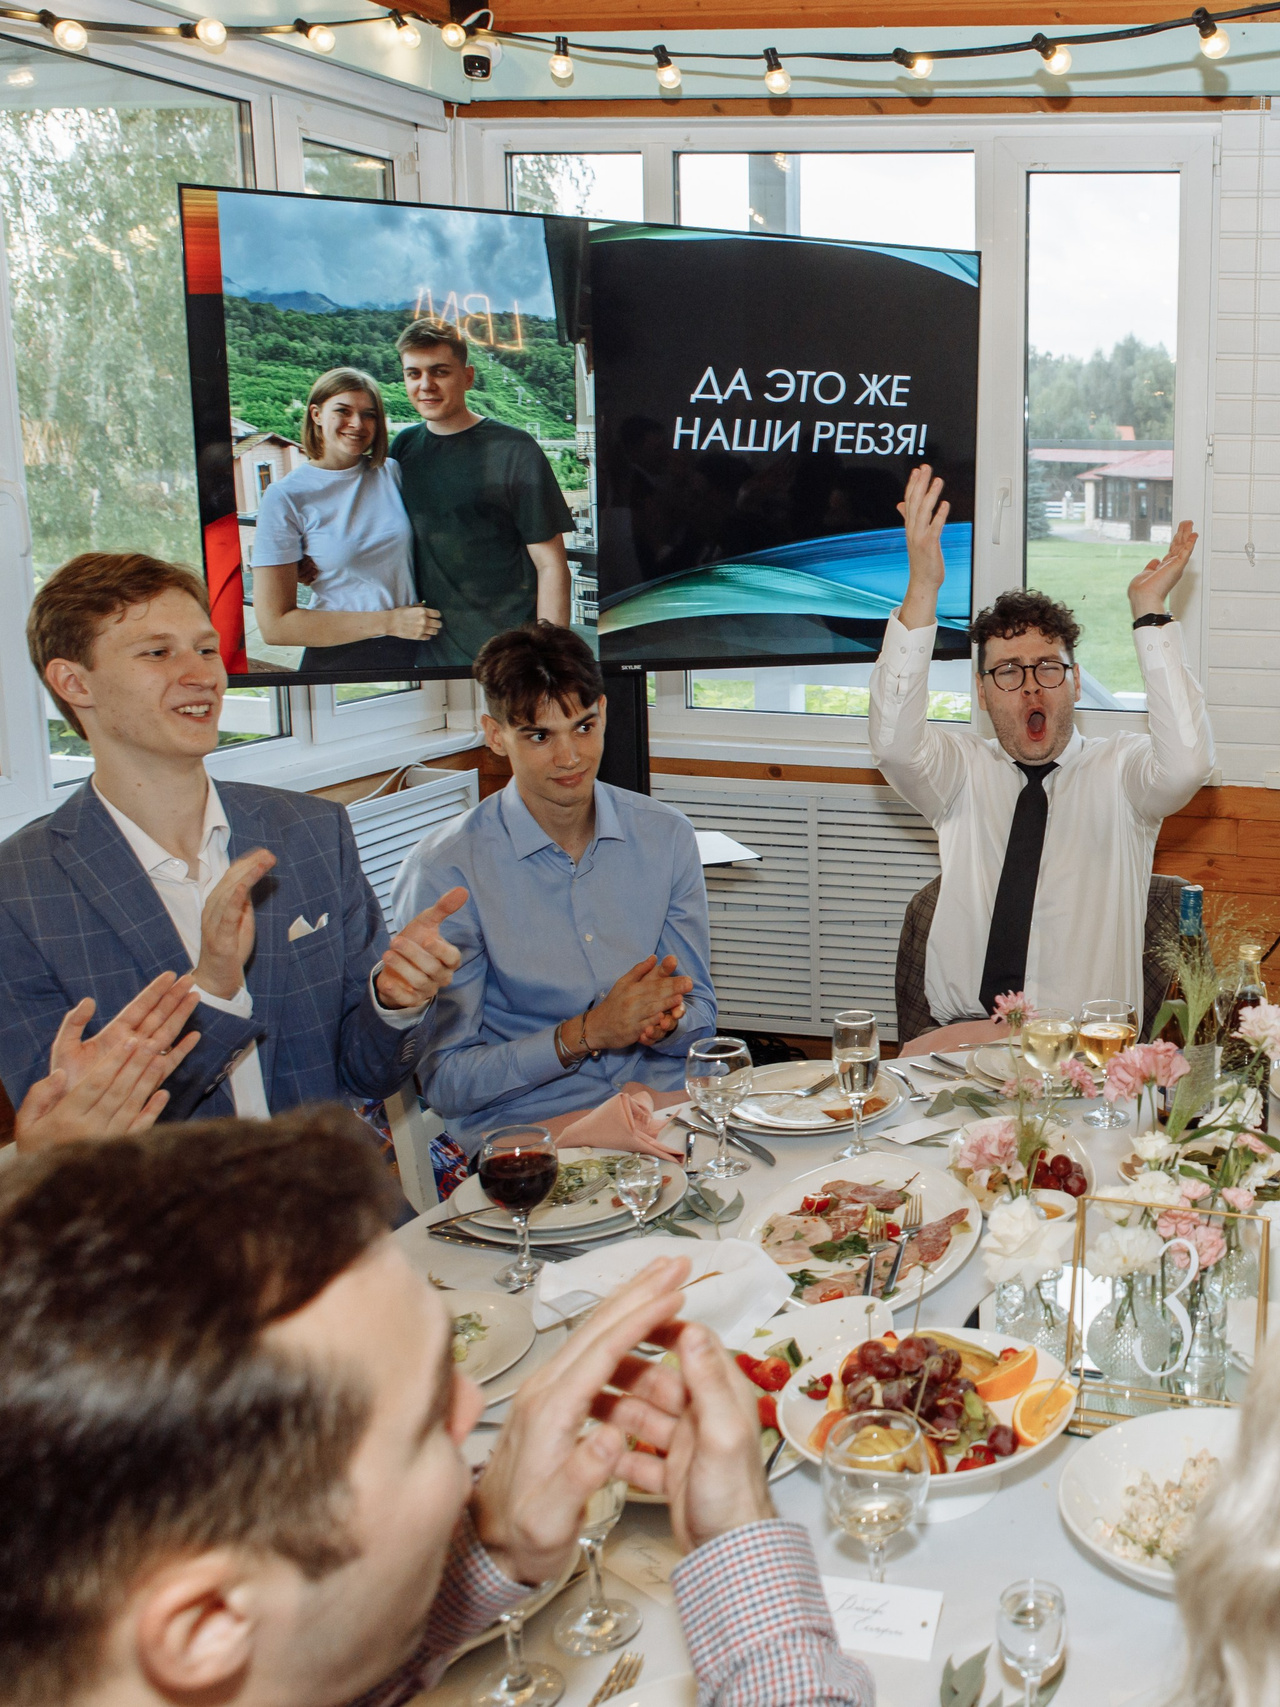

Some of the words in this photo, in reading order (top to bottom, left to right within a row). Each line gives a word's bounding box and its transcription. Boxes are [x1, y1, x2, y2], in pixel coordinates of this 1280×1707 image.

[689, 366, 753, 404] ДА
[763, 368, 847, 405] ЭТО
[853, 373, 912, 407] ЖЕ
[672, 416, 801, 452] НАШИ
[811, 421, 928, 456] РЕБЗЯ!
[1133, 1237, 1199, 1377] 3
